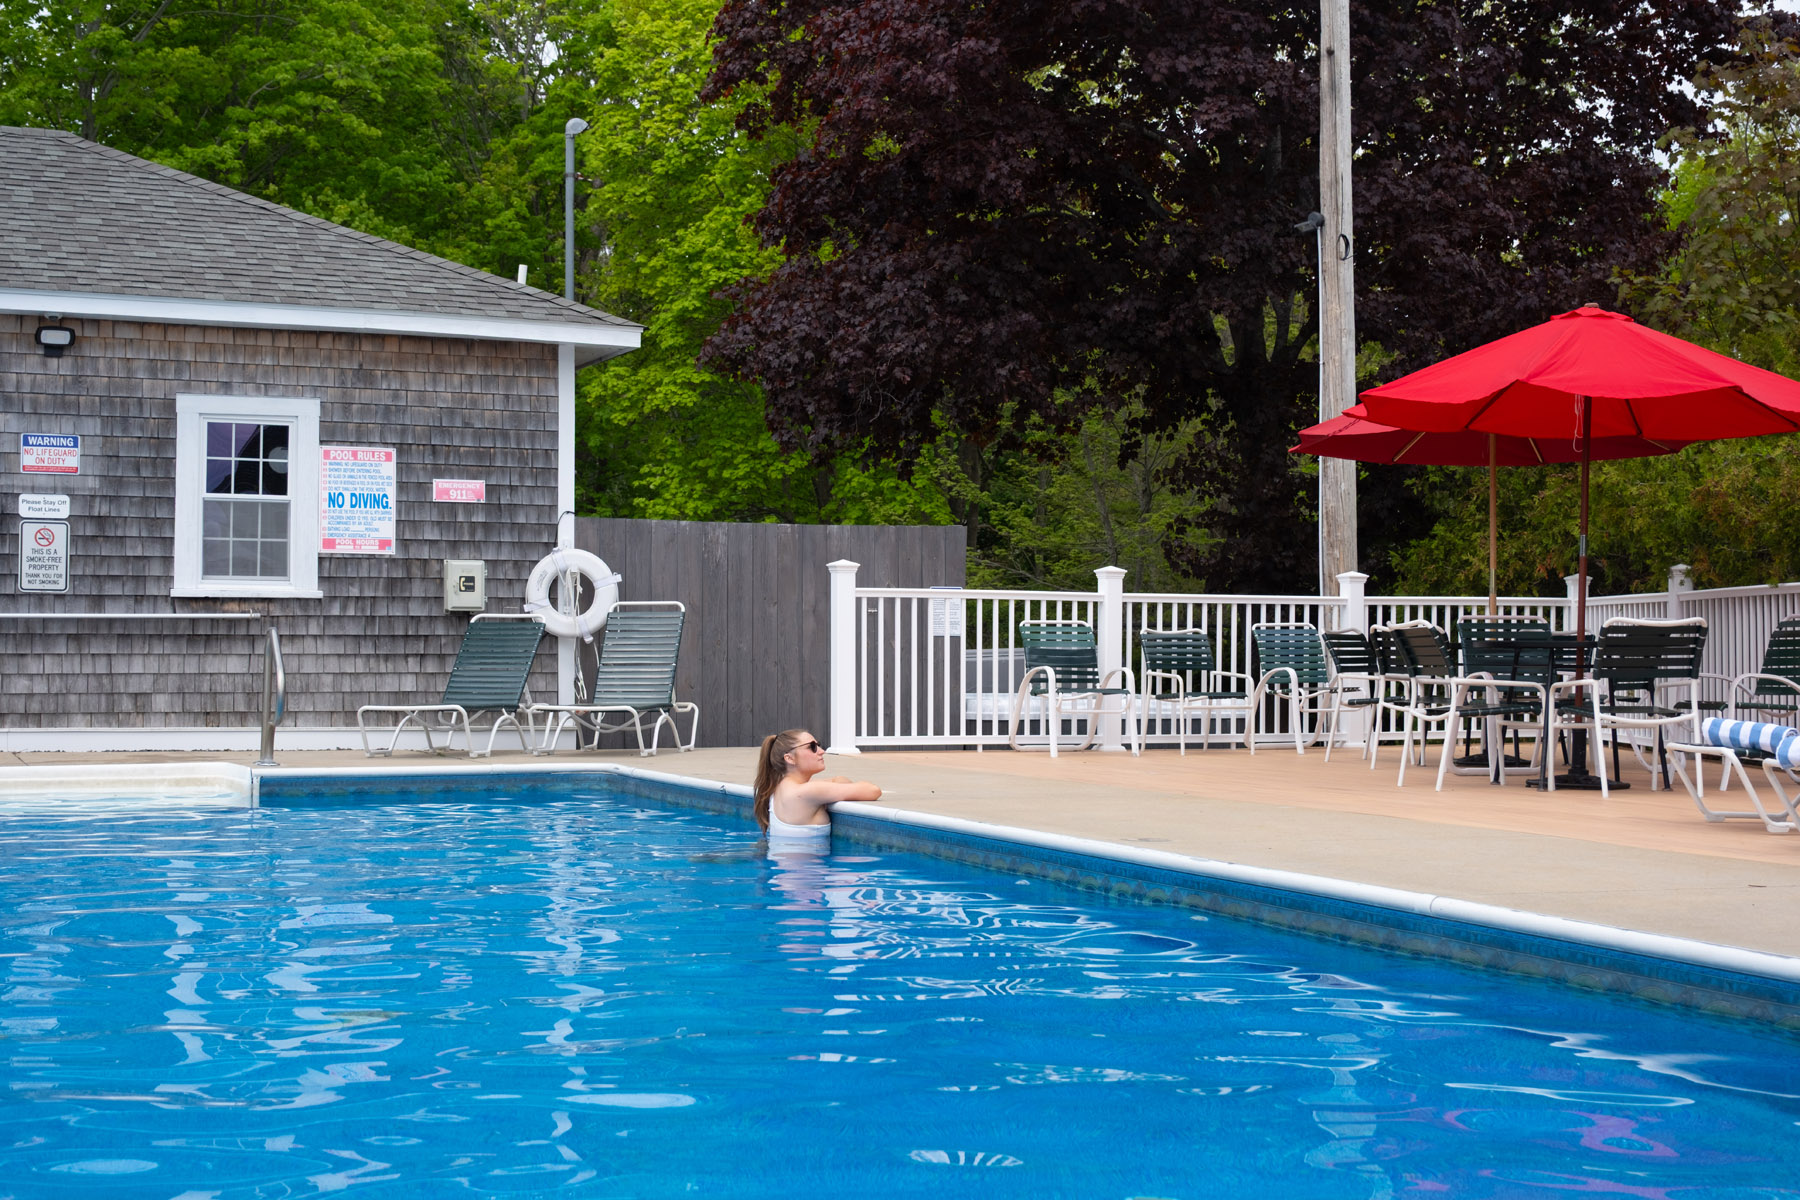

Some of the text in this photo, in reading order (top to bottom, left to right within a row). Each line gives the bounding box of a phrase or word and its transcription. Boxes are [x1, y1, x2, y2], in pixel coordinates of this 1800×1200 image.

[28, 436, 74, 447] WARNING
[24, 448, 77, 457] NO LIFEGUARD
[330, 450, 386, 460] POOL RULES
[35, 457, 66, 465] ON DUTY
[450, 489, 467, 499] 911
[328, 492, 392, 509] NO DIVING.
